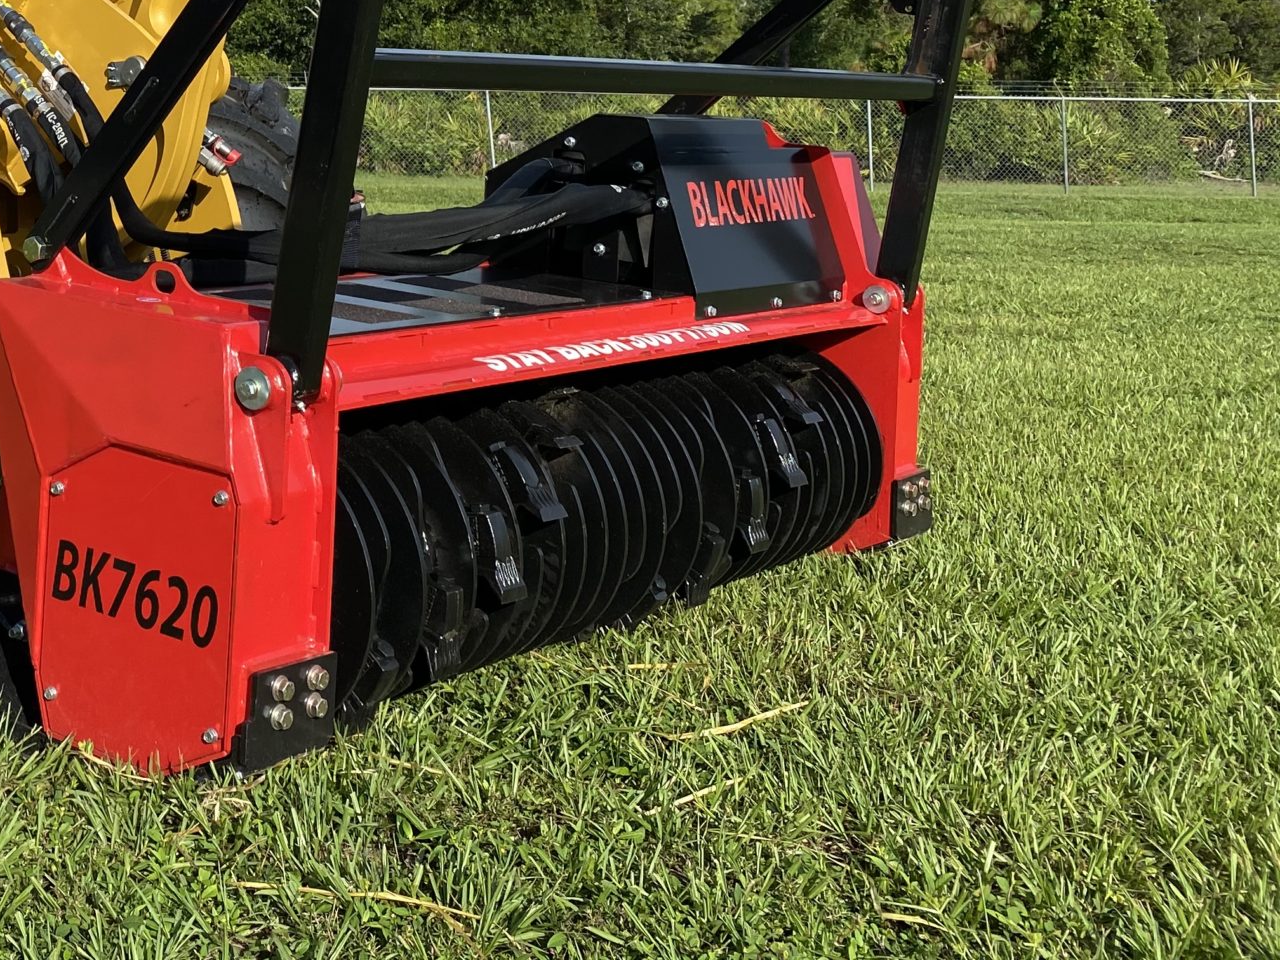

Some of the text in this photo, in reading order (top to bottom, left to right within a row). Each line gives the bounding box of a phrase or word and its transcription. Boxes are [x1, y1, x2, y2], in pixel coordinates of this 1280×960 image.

[686, 177, 813, 228] BLACKHAWK
[472, 349, 556, 372] STAY
[544, 336, 634, 361] BACK
[52, 539, 218, 649] BK7620
